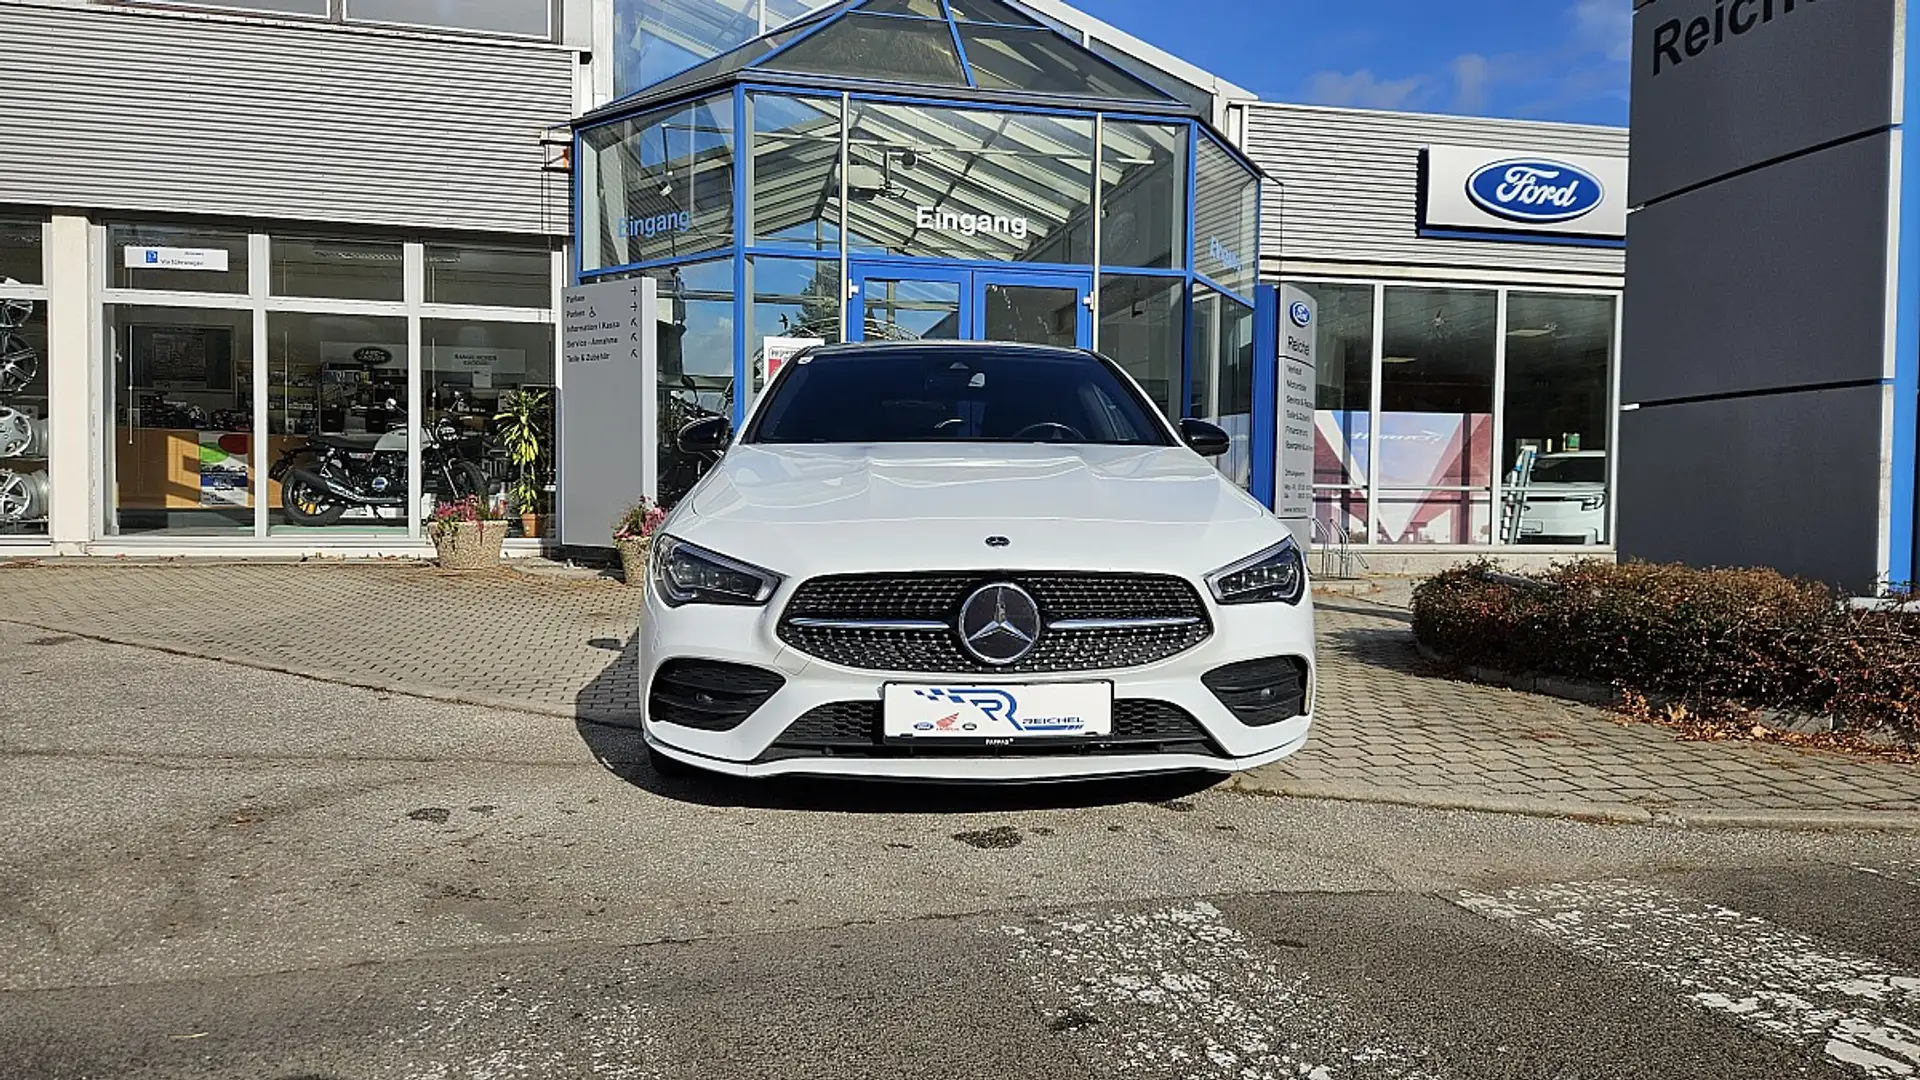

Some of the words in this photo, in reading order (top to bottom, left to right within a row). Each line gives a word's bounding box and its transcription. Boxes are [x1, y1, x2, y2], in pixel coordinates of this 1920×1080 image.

[1495, 165, 1579, 208] Ford
[616, 210, 690, 239] Eingang
[916, 205, 1028, 239] Eingang
[566, 310, 585, 318] Parken
[566, 323, 598, 333] Information
[1022, 716, 1084, 725] REICHEL
